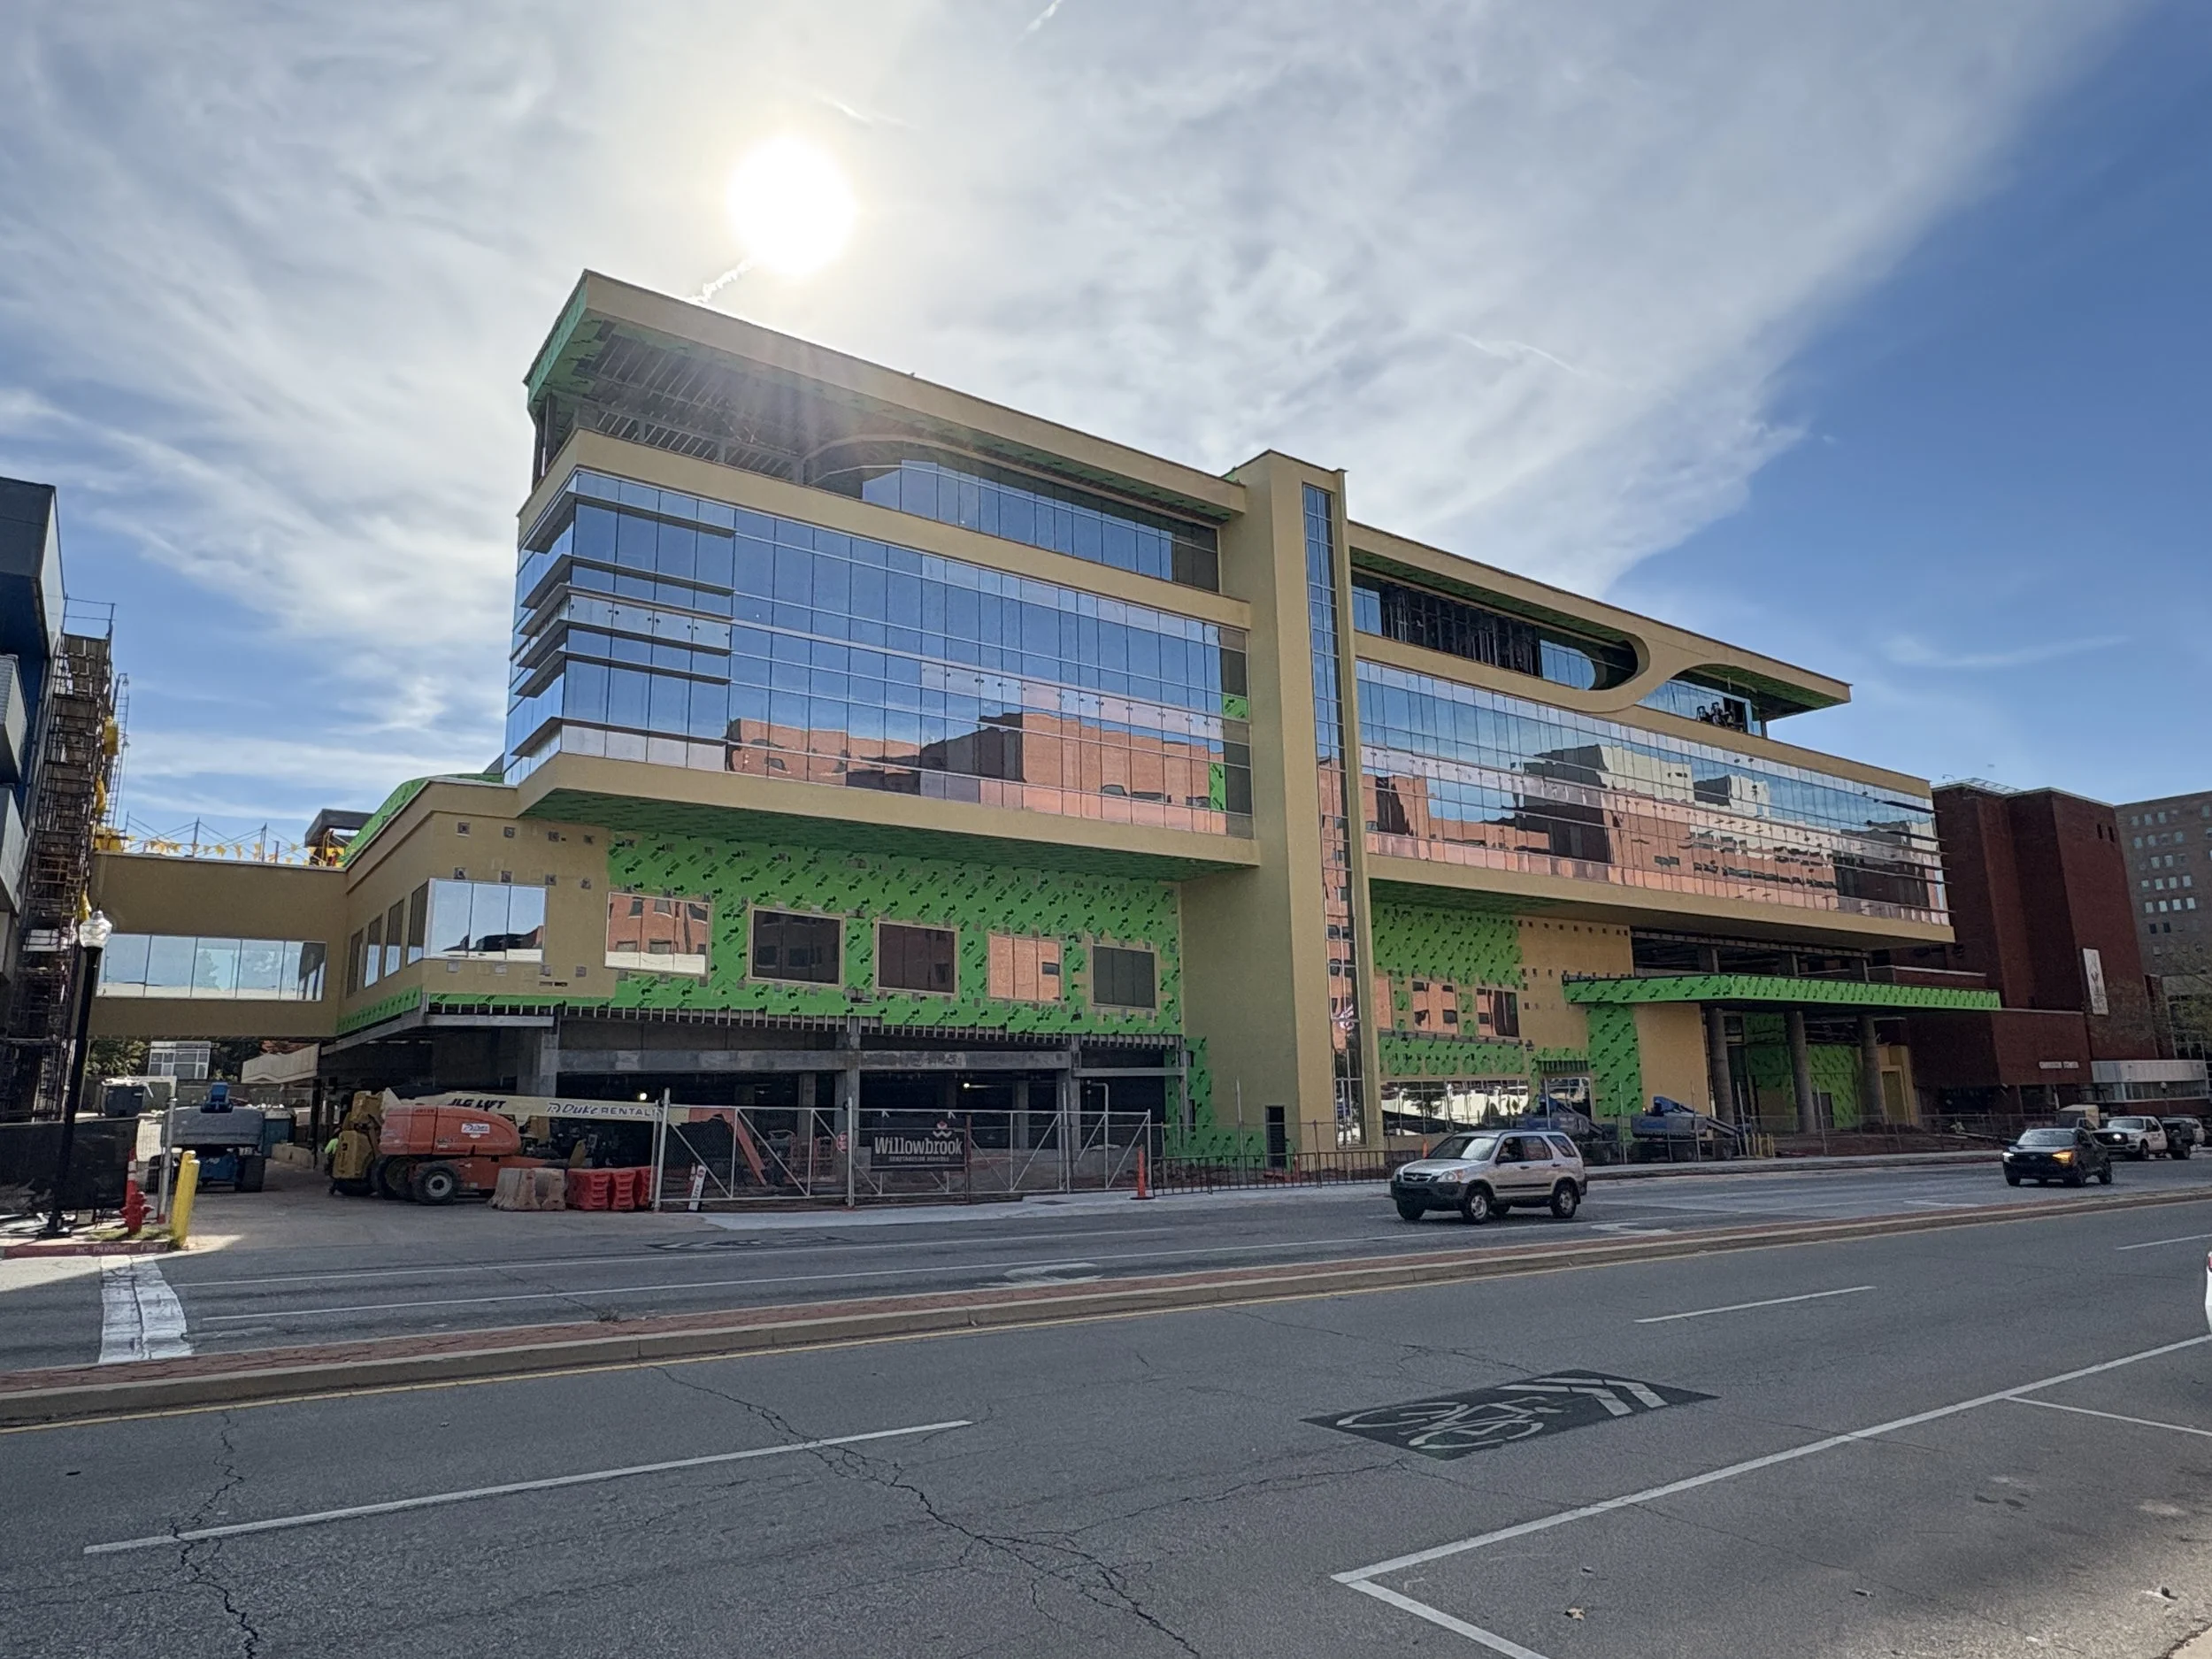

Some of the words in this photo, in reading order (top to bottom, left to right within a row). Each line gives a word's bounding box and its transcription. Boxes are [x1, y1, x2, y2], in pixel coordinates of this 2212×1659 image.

[447, 1098, 474, 1107] JLG
[475, 1099, 507, 1110] LIFT
[874, 1136, 964, 1155] Willowbrook
